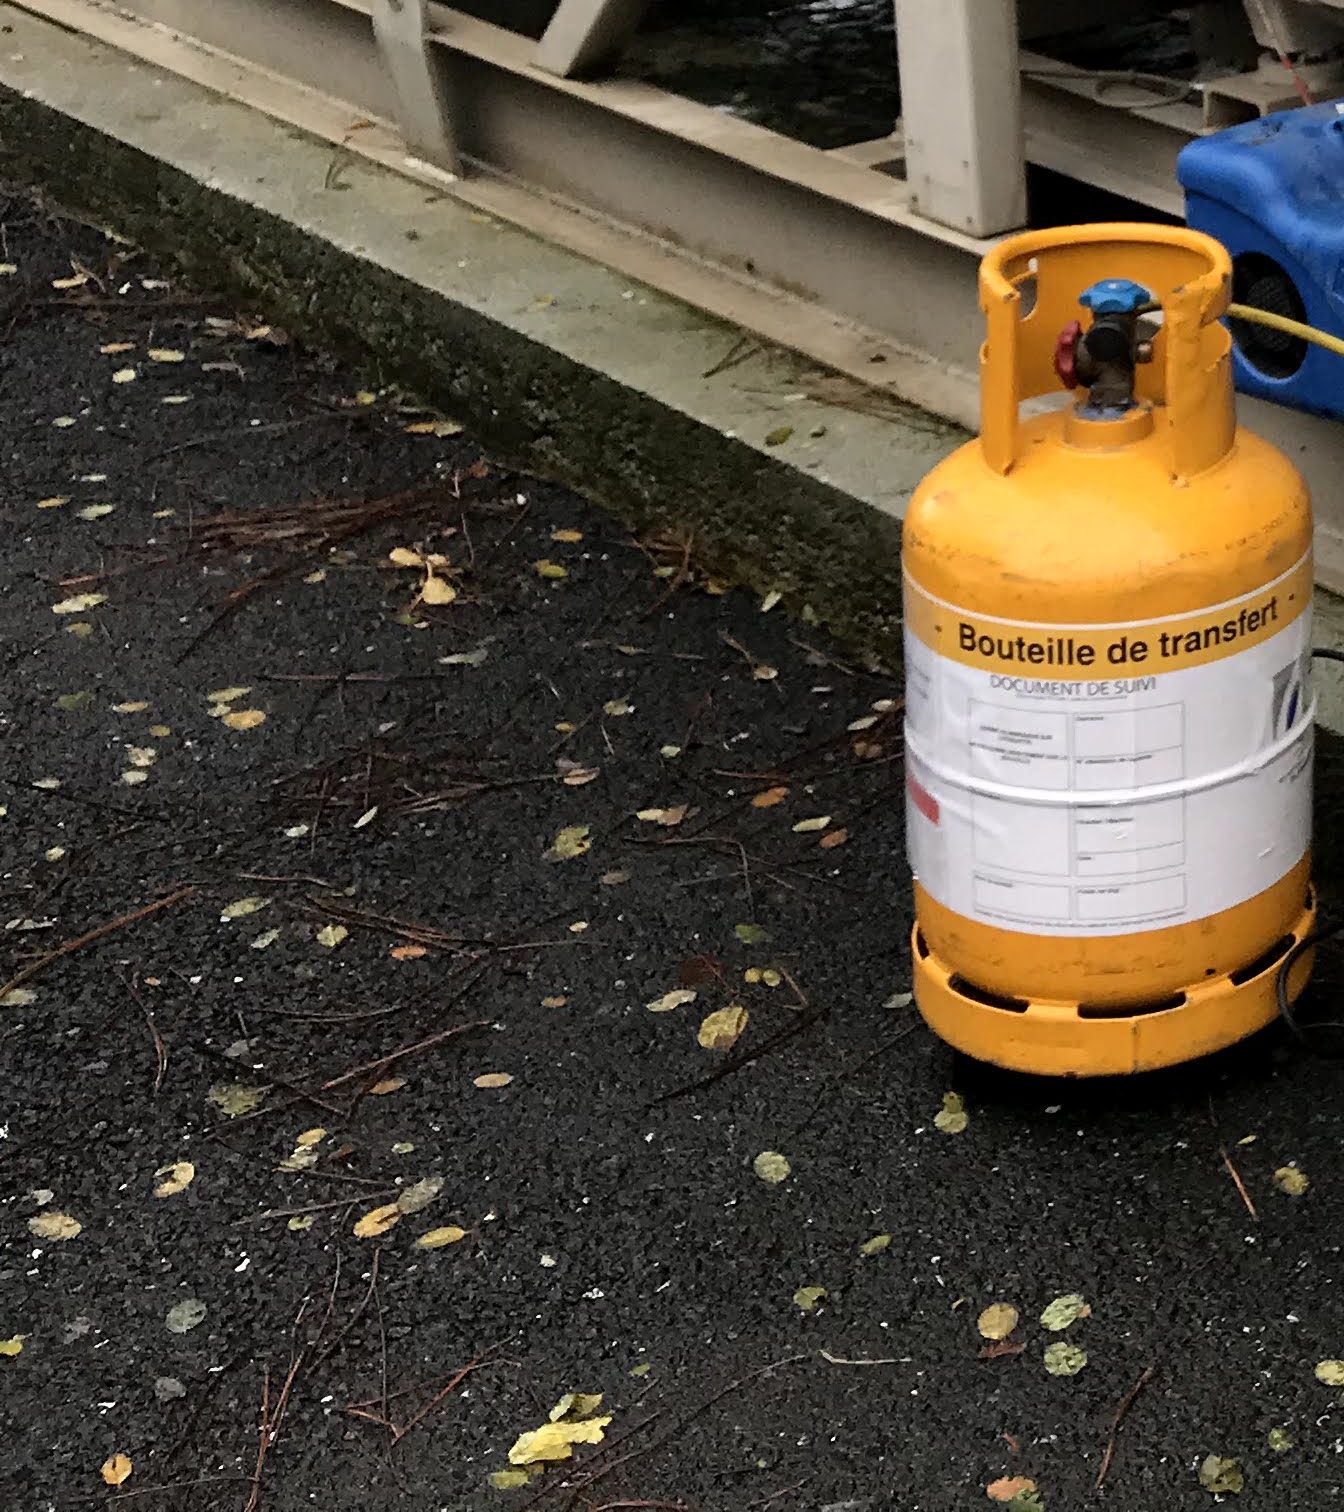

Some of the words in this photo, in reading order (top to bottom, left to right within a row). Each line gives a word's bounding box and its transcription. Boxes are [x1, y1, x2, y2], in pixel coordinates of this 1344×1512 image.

[958, 622, 1096, 666] Bouteille
[1106, 635, 1149, 665] de
[1159, 595, 1280, 659] transfert
[989, 674, 1083, 696] DOCUMENT
[1086, 681, 1109, 696] DE
[1113, 676, 1157, 695] SUIVI
